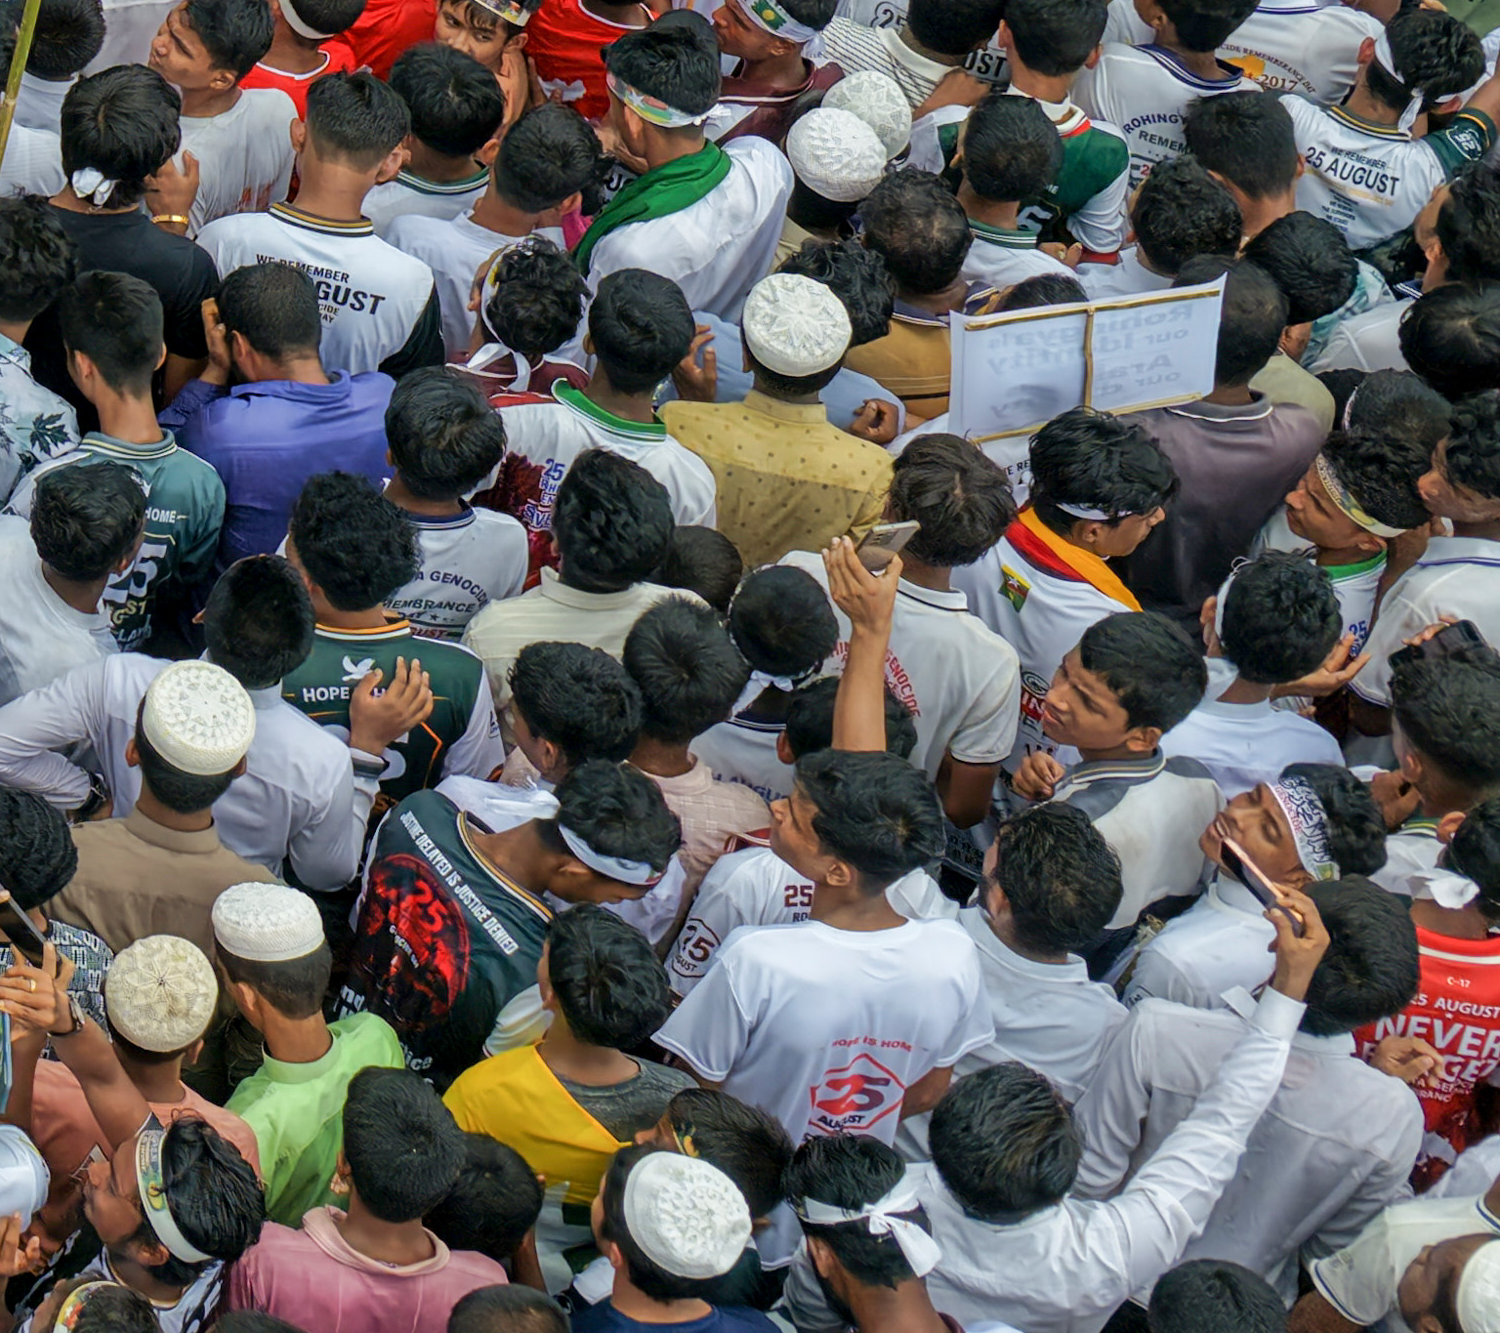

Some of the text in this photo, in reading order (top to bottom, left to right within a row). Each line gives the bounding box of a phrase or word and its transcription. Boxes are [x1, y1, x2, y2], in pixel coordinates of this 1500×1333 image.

[1304, 146, 1400, 197] 25 AUGUST
[301, 685, 350, 702] HOPE
[415, 835, 453, 876] DELAYED
[445, 869, 462, 888] IS
[453, 882, 492, 924] JUSTICE
[483, 915, 520, 956] DENIED
